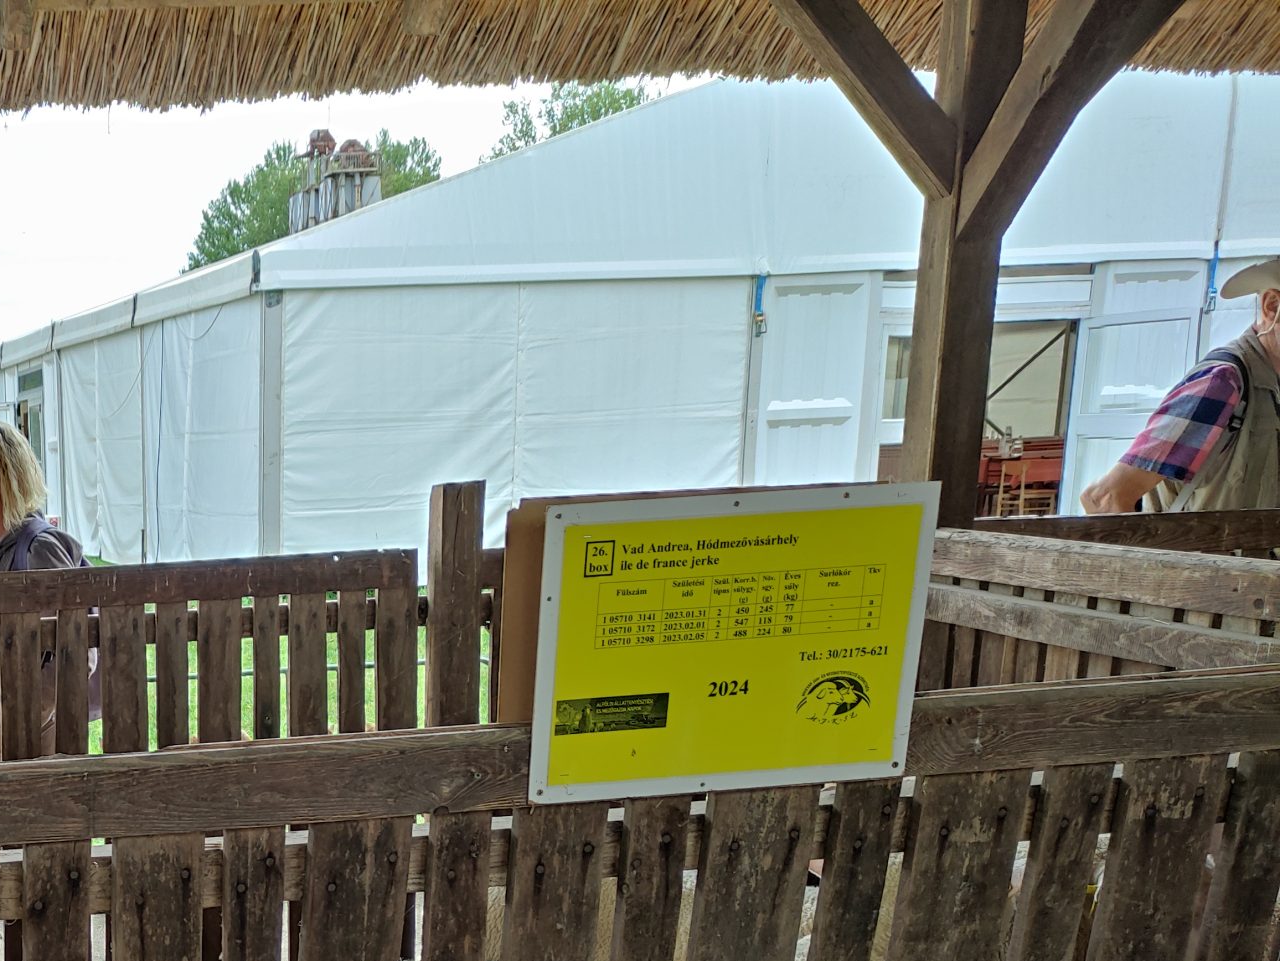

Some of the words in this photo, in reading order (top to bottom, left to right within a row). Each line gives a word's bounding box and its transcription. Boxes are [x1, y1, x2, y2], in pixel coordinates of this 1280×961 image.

[622, 544, 644, 555] Vad
[647, 542, 693, 554] Andrea,
[696, 534, 799, 550] Hódmezővásárhely
[592, 546, 608, 557] 26.
[589, 562, 609, 573] box
[621, 560, 633, 571] ile
[636, 559, 650, 570] de
[653, 558, 688, 569] france
[690, 555, 720, 569] jerke
[784, 570, 801, 580] Éves
[672, 579, 705, 588] Születési
[616, 588, 648, 597] Fülszám
[681, 590, 694, 598] idő
[783, 593, 798, 602] (kg)
[609, 614, 633, 624] 05710
[637, 613, 656, 621] 3141
[735, 606, 750, 614] 450
[759, 605, 774, 613] 245
[785, 603, 794, 611] 77
[608, 626, 632, 635] 05710
[636, 624, 655, 633] 3172
[734, 618, 749, 626] 547
[758, 617, 772, 625] 118
[784, 615, 793, 623] 79
[607, 637, 632, 647] 05710
[635, 636, 655, 645] 3298
[733, 629, 748, 638] 488
[757, 628, 771, 636] 224
[782, 626, 792, 634] 80
[799, 651, 823, 661] Tel.:
[826, 645, 888, 660] 30/2175-621
[708, 679, 749, 698] 2024
